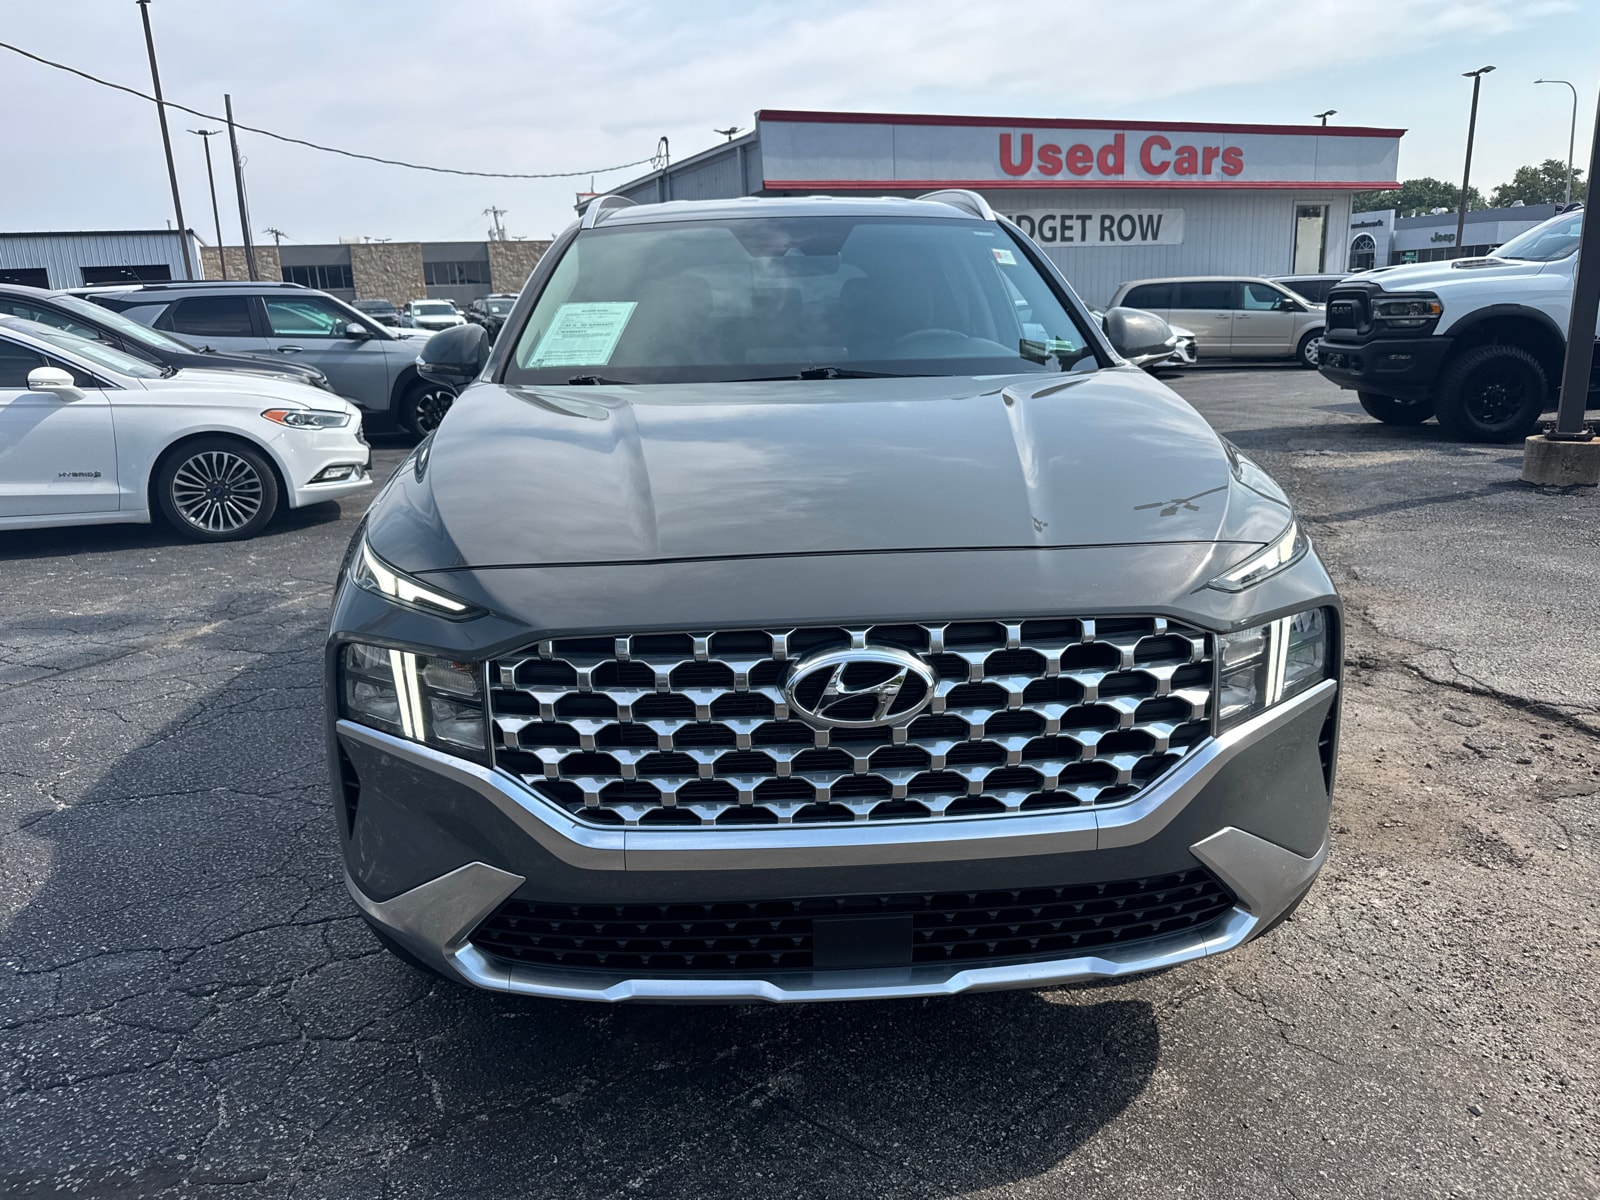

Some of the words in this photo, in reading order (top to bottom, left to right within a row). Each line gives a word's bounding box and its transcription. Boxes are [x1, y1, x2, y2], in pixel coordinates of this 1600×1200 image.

[999, 133, 1125, 177] Used
[1139, 134, 1245, 177] Cars
[1099, 213, 1163, 242] ROW
[1430, 231, 1456, 243] Jeep
